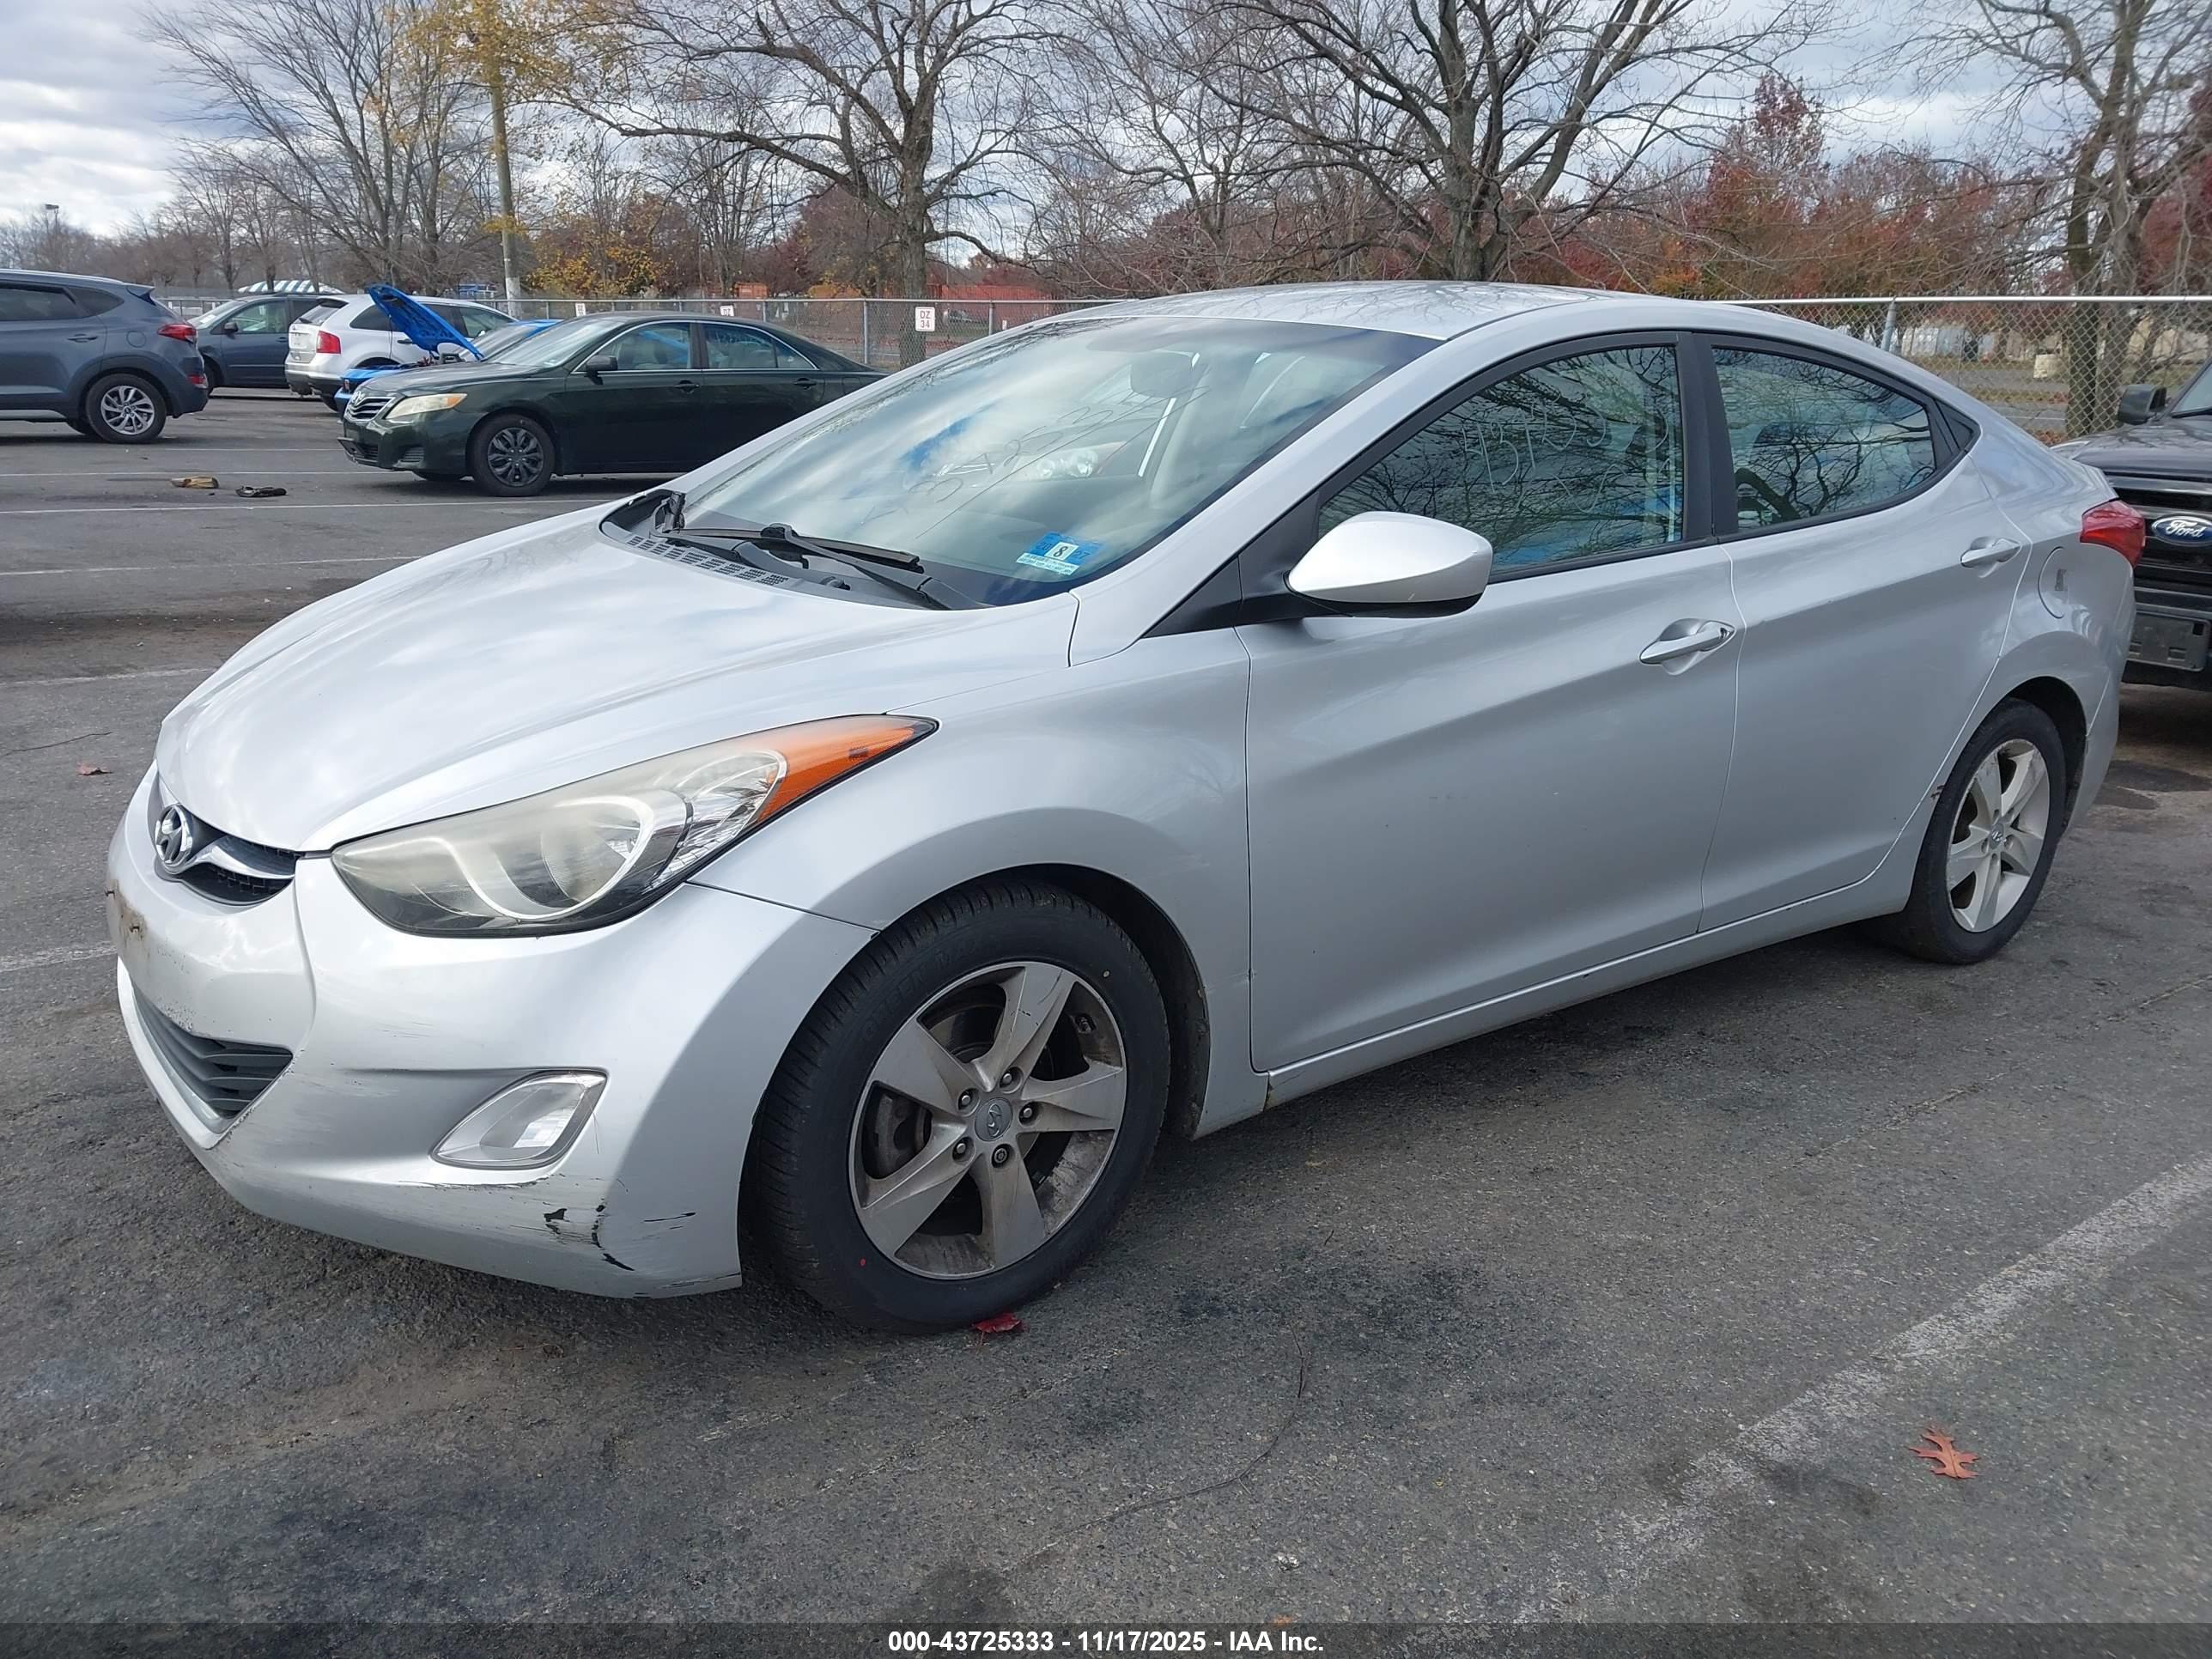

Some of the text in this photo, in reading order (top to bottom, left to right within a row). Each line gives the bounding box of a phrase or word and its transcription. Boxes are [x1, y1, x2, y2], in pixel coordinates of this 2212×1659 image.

[920, 310, 931, 319] DZ
[920, 319, 930, 329] 34
[2165, 520, 2208, 538] Ford
[1053, 545, 1069, 557] 8
[1073, 550, 1091, 560] 27
